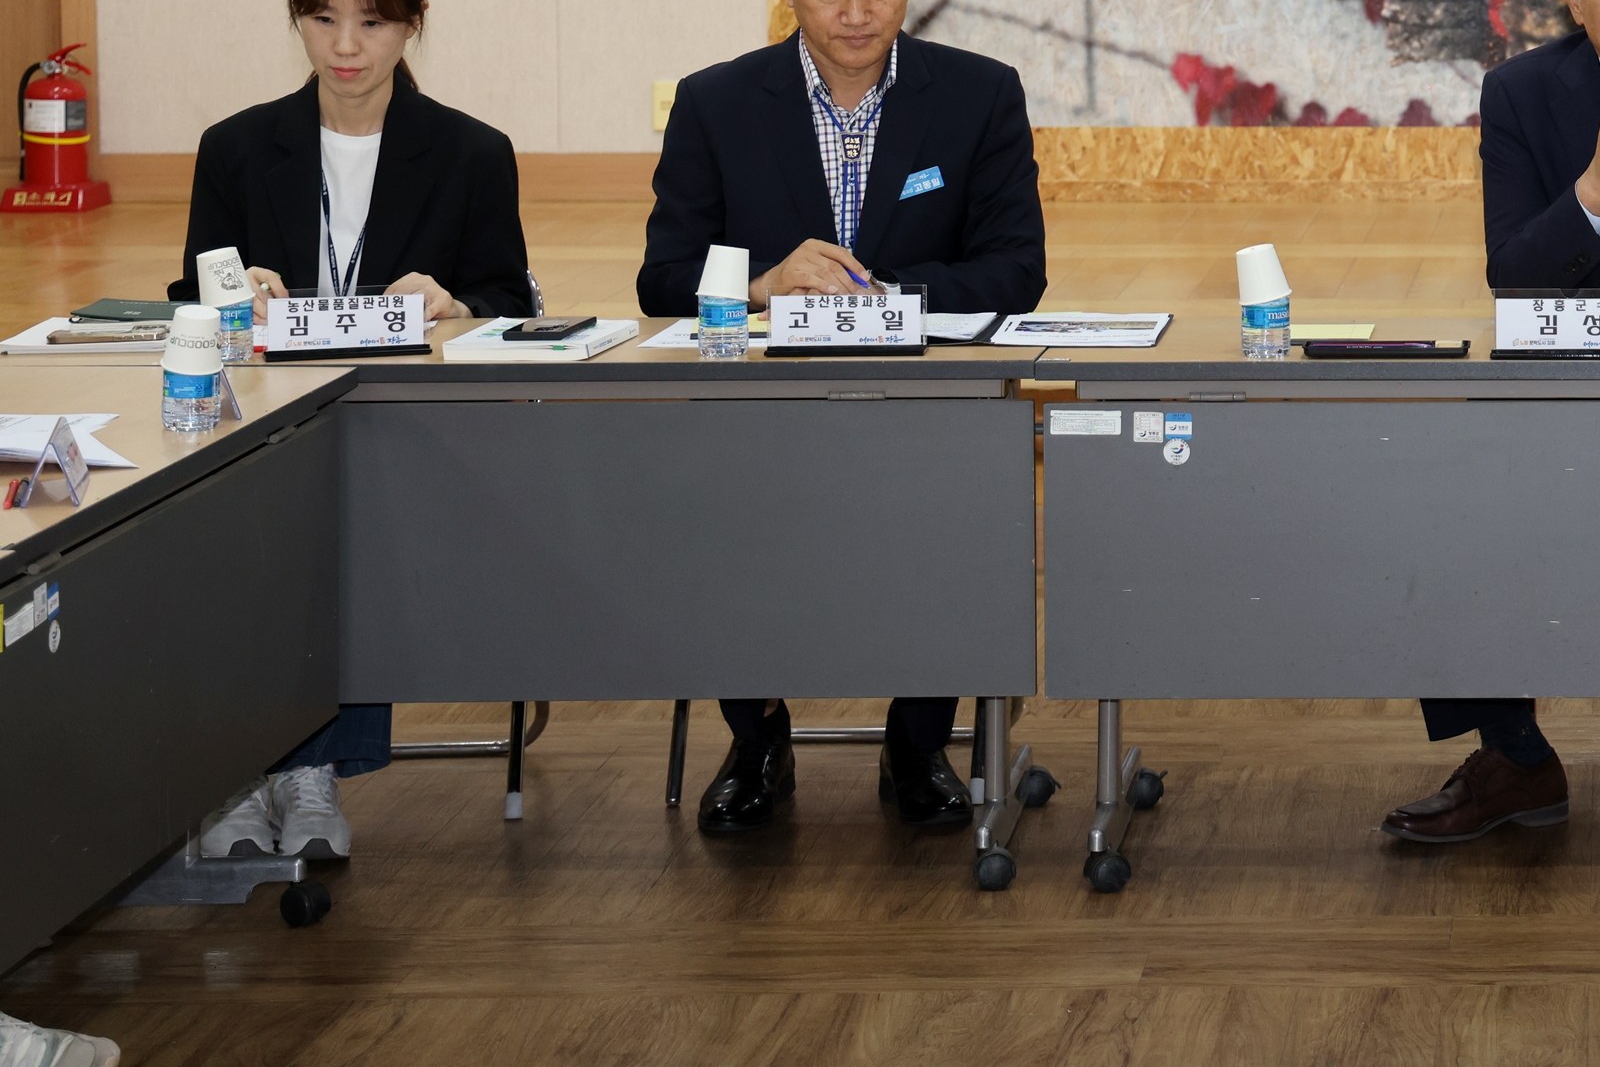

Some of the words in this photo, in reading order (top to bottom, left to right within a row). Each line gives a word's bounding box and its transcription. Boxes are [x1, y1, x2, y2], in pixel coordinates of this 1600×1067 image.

[287, 295, 404, 313] 농산물품질관리원
[803, 295, 888, 309] 농산유통과장
[169, 336, 217, 348] GOODCUP
